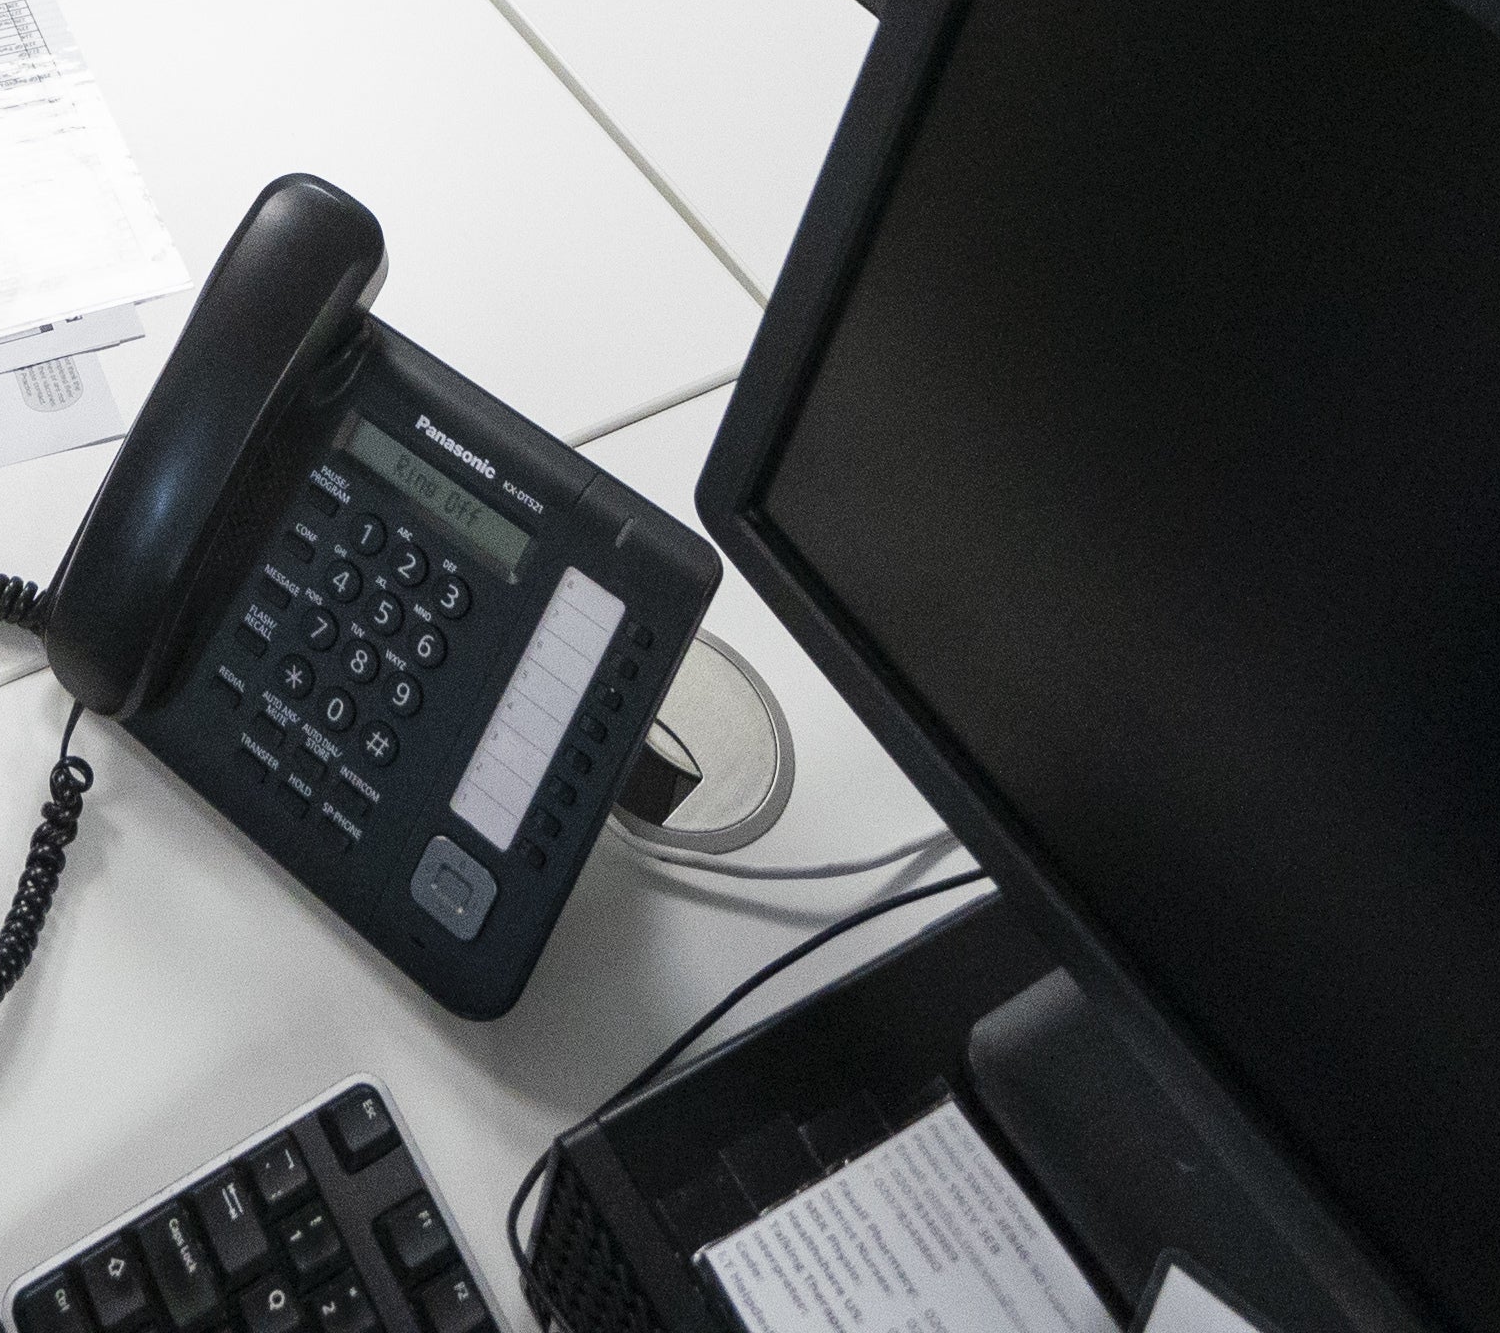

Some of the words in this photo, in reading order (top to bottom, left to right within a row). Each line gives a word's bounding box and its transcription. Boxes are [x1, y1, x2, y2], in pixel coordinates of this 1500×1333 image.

[412, 413, 501, 481] Panasonic
[307, 469, 353, 505] PROGRAM
[317, 463, 352, 492] PAUSE/
[292, 520, 320, 545] CONF
[354, 520, 376, 546] 1
[395, 525, 414, 542] ABC
[331, 543, 349, 559] GHI
[395, 551, 421, 579] 2
[260, 563, 303, 598] MESSAGE
[440, 558, 459, 575] DEF
[327, 567, 354, 595] 4
[302, 586, 326, 607] PQRS
[436, 582, 464, 611] 3
[246, 603, 279, 631] FLASH/
[371, 599, 396, 627] 5
[410, 602, 434, 623] MNO
[240, 612, 277, 642] RECALL
[305, 615, 330, 642] 7
[348, 622, 367, 639] TUV
[412, 630, 440, 660] 6
[346, 647, 372, 676] 8
[381, 648, 409, 672] WXYZ
[214, 664, 250, 694] REDIAL
[260, 689, 285, 711] AUTO
[279, 704, 303, 725] ANS/
[322, 694, 348, 723] 0
[389, 680, 415, 709] 9
[262, 704, 290, 728] MUTE
[235, 732, 284, 772] TRANSFER
[299, 721, 325, 743] AUTO
[318, 737, 344, 760] DIAL/
[302, 736, 333, 763] STORE
[285, 772, 316, 798] HOLD
[335, 765, 384, 804] INTERCOM
[316, 800, 367, 842] SP-PHONE
[361, 1098, 378, 1120] Esc
[818, 1187, 859, 1243] District
[167, 1216, 185, 1247] Caps
[178, 1244, 198, 1275] Lock
[53, 1287, 71, 1313] Ctrl
[267, 1288, 286, 1311] Q
[454, 1281, 470, 1303] F2
[321, 1300, 338, 1317] 2
